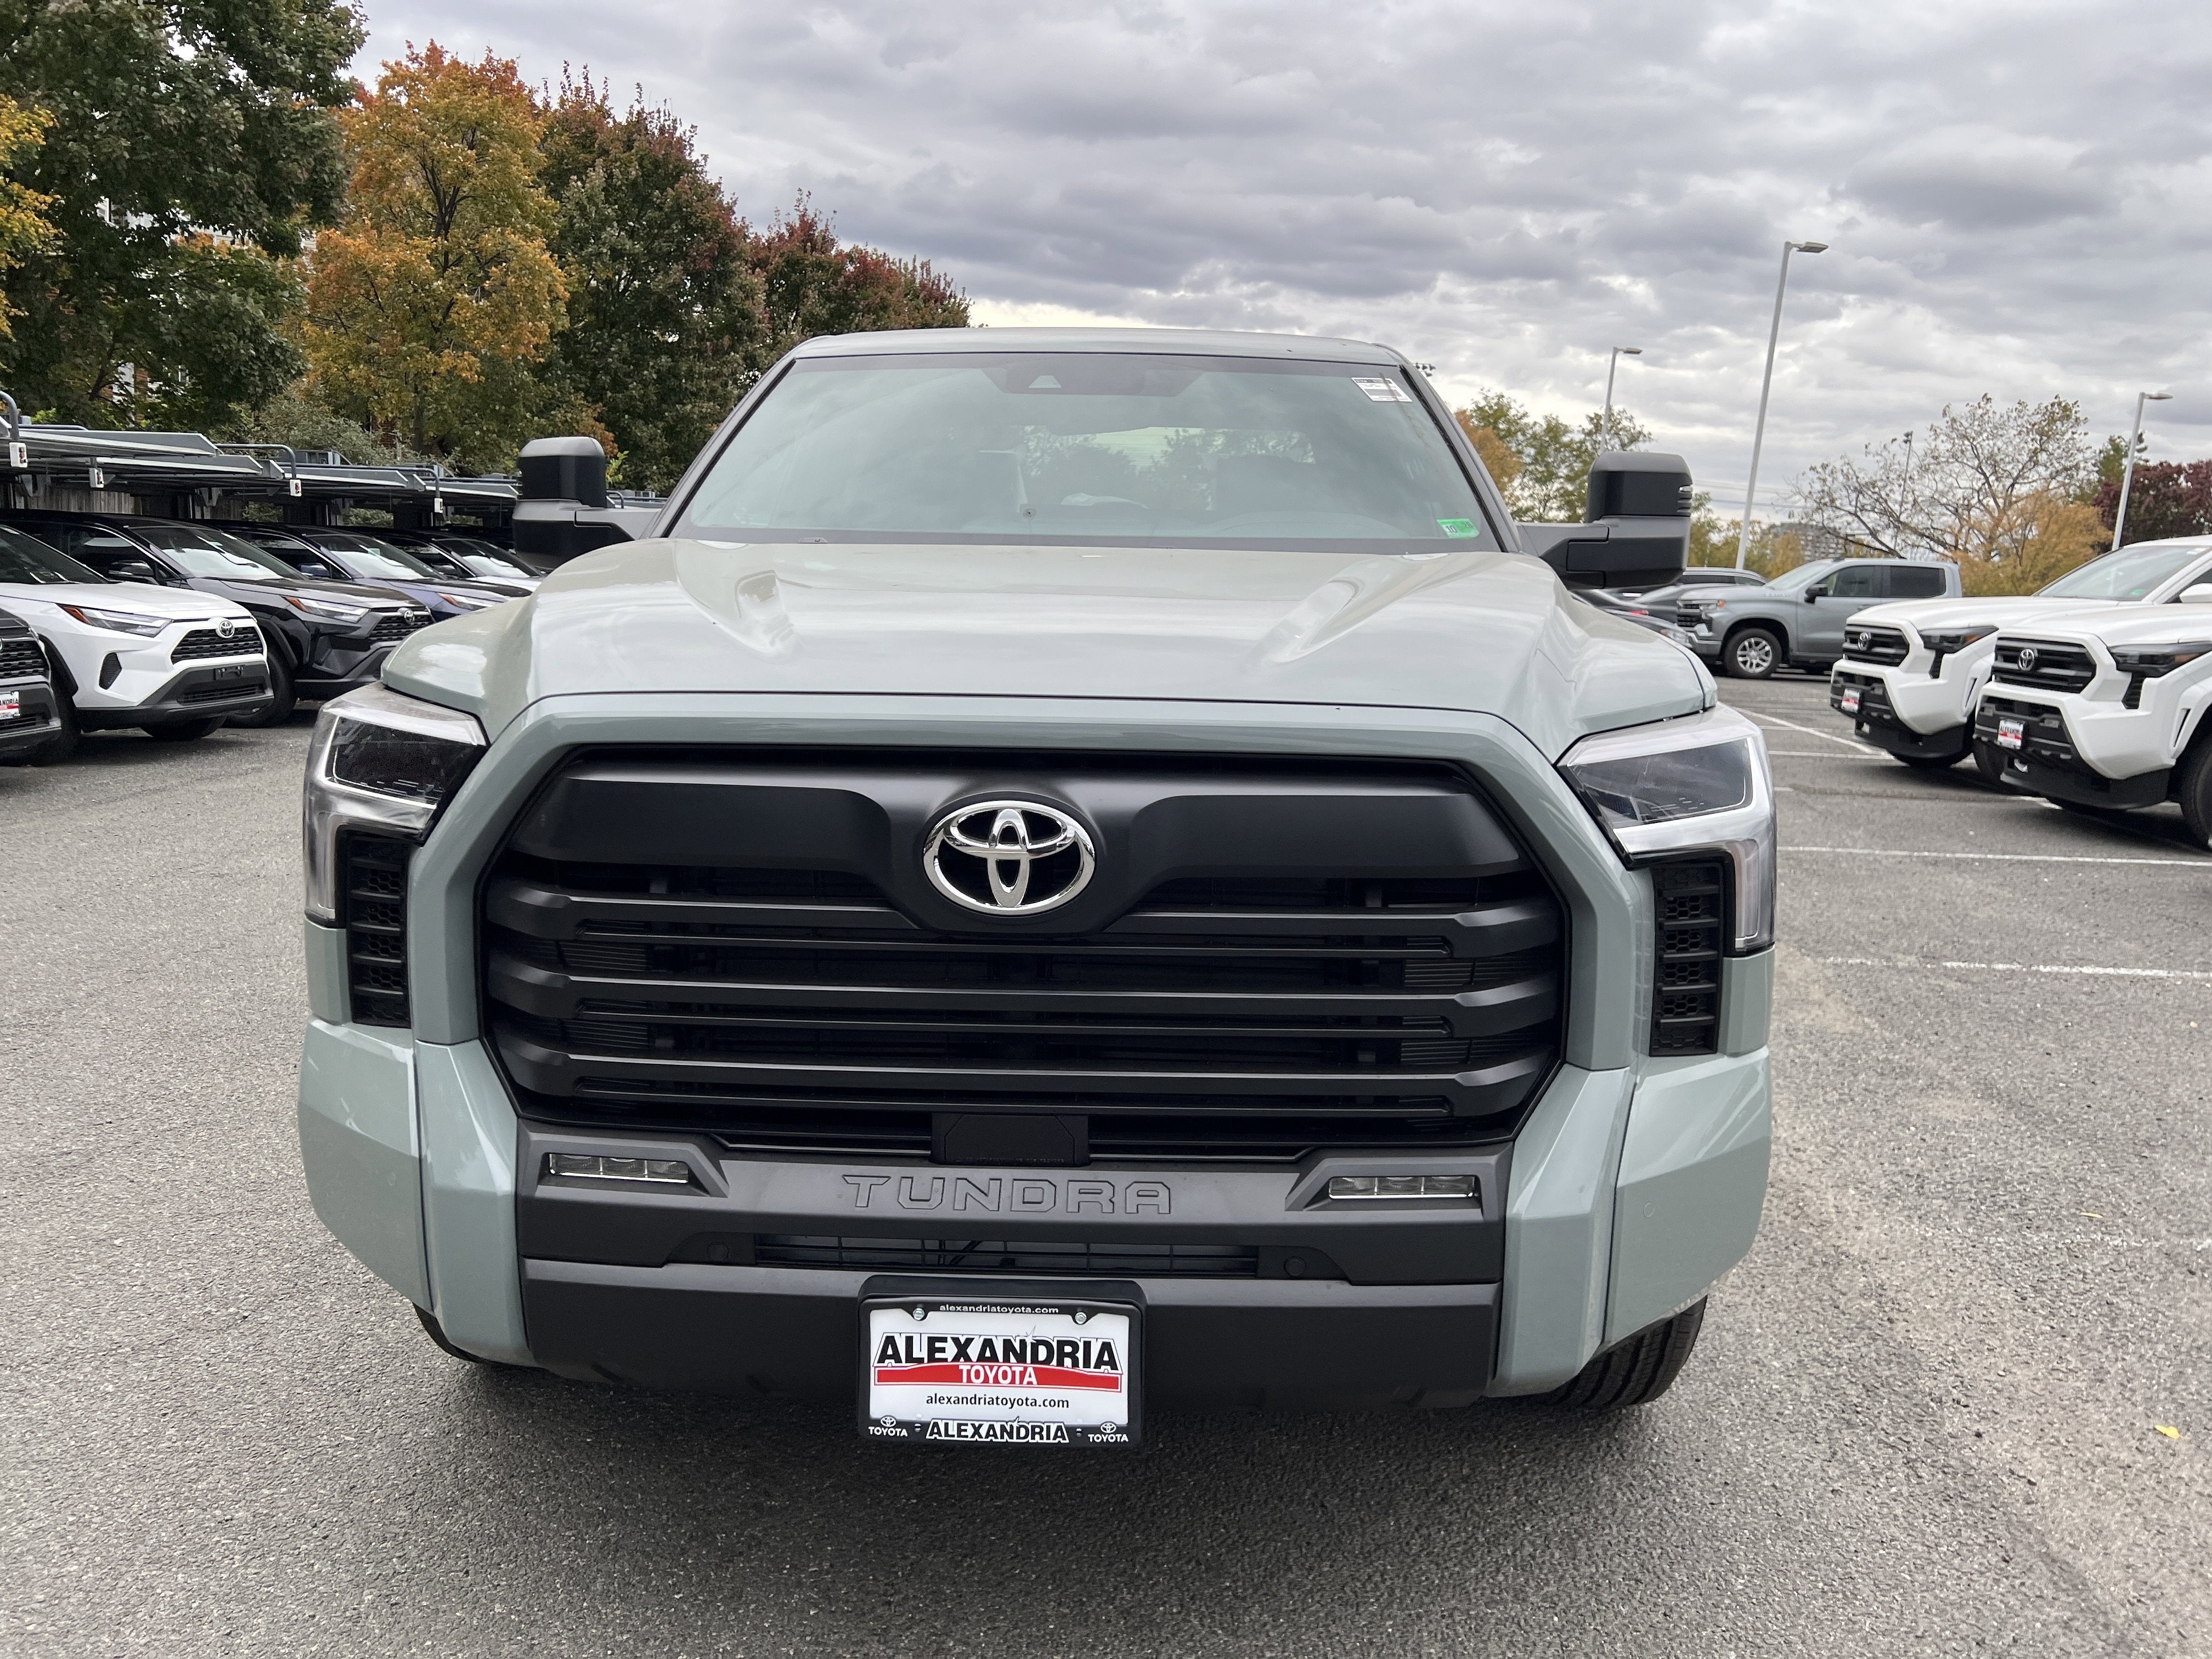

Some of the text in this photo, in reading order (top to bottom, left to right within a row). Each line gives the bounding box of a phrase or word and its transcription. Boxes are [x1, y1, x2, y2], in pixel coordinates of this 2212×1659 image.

[842, 1174, 1171, 1215] TUNDRA
[939, 1304, 1059, 1314] alexandriatoyota.com
[874, 1333, 1122, 1374] ALEXANDRIA
[958, 1364, 1038, 1385] TOYOTA
[926, 1392, 1070, 1409] alexandriatoyota.com
[868, 1426, 908, 1437] TOYOTA
[927, 1418, 1069, 1443] ALEXANDRIA
[1088, 1433, 1129, 1443] TOYOTA
